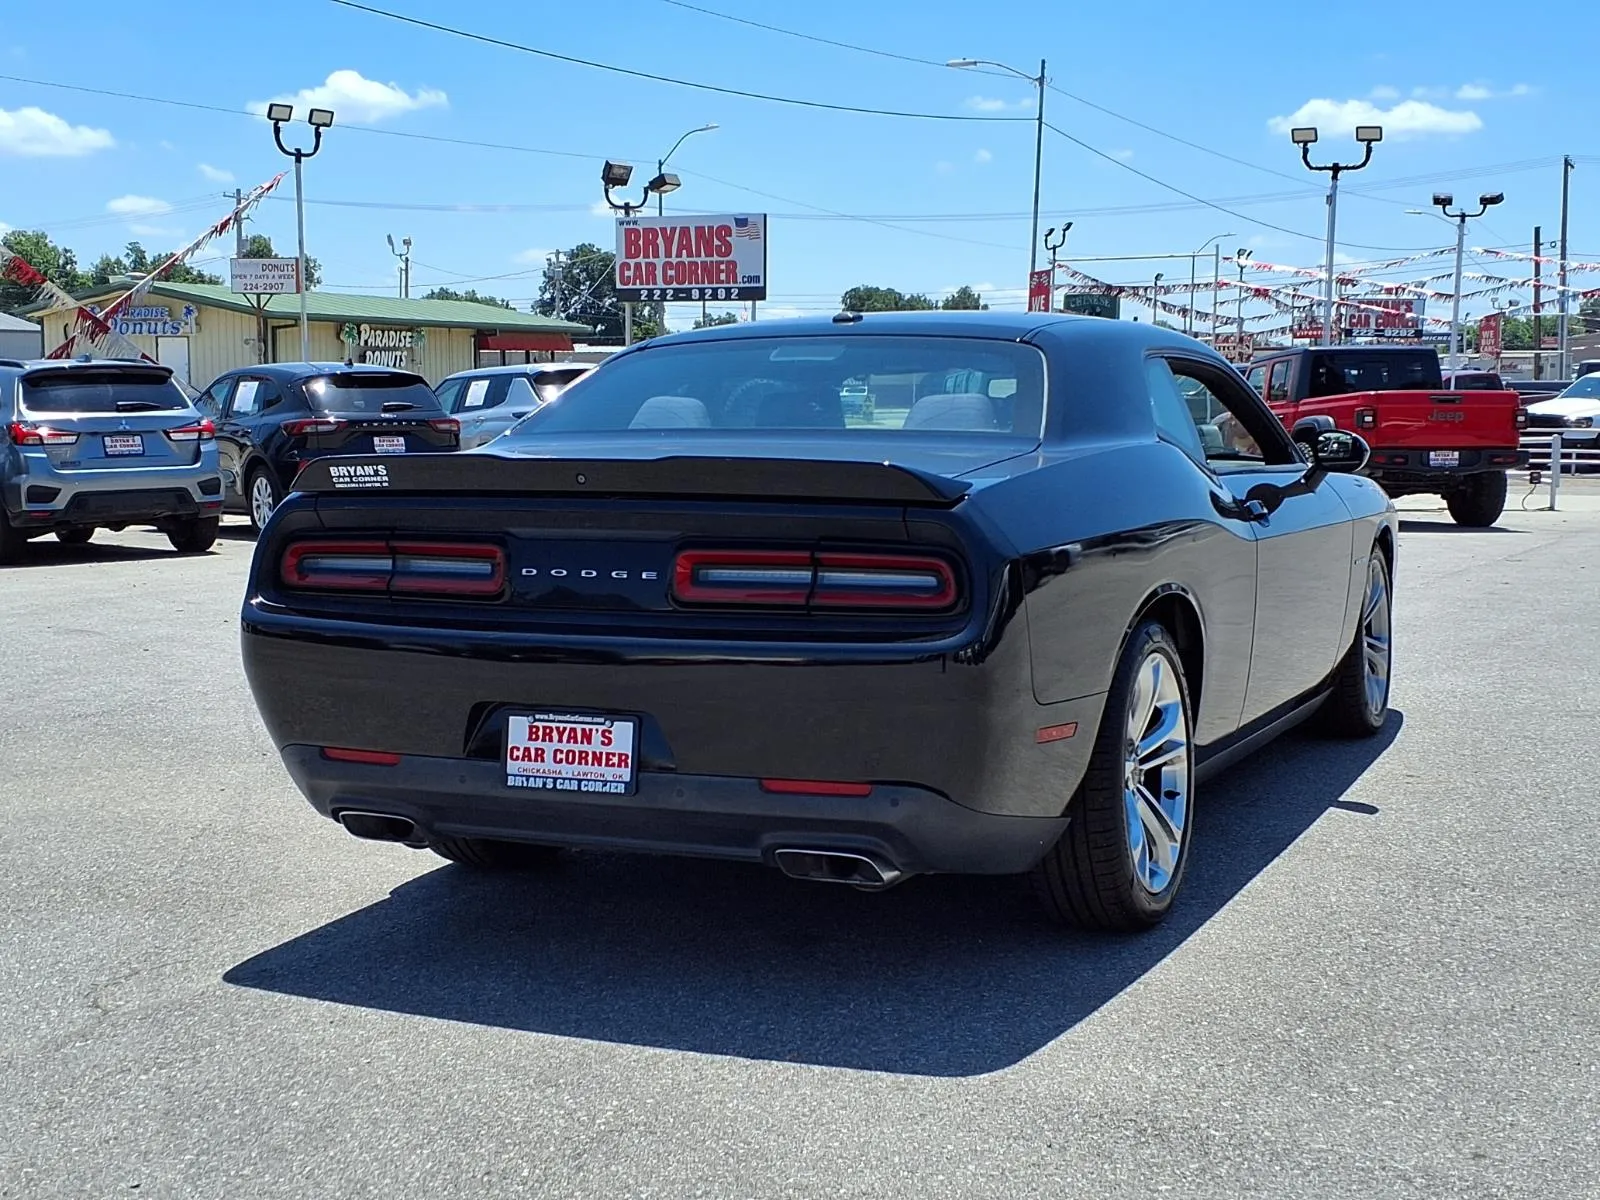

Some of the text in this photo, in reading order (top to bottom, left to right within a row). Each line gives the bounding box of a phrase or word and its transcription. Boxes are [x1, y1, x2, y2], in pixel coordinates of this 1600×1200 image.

[618, 219, 640, 227] www.
[624, 224, 733, 260] BRYANS
[261, 263, 295, 273] DONUTS
[618, 261, 657, 286] CAR
[243, 282, 285, 291] 224-2907
[1031, 295, 1046, 313] WE
[1069, 294, 1112, 308] CHINESE
[1357, 300, 1414, 313] YAN'S
[1348, 313, 1371, 328] CAR
[359, 323, 412, 347] PARADISE
[1481, 330, 1495, 339] WE
[1480, 338, 1495, 346] BUY
[365, 350, 408, 368] DONUTS
[1427, 408, 1465, 424] Jeep
[329, 464, 388, 477] BRYAN'S
[521, 567, 658, 580] DODGE
[527, 724, 613, 747] BRYAN'S
[509, 745, 630, 769] CAR CORNER
[517, 766, 563, 776] CHICKASHA
[571, 770, 608, 780] LAWTON,
[506, 775, 554, 790] BRYAN'S
[556, 778, 578, 791] CAR
